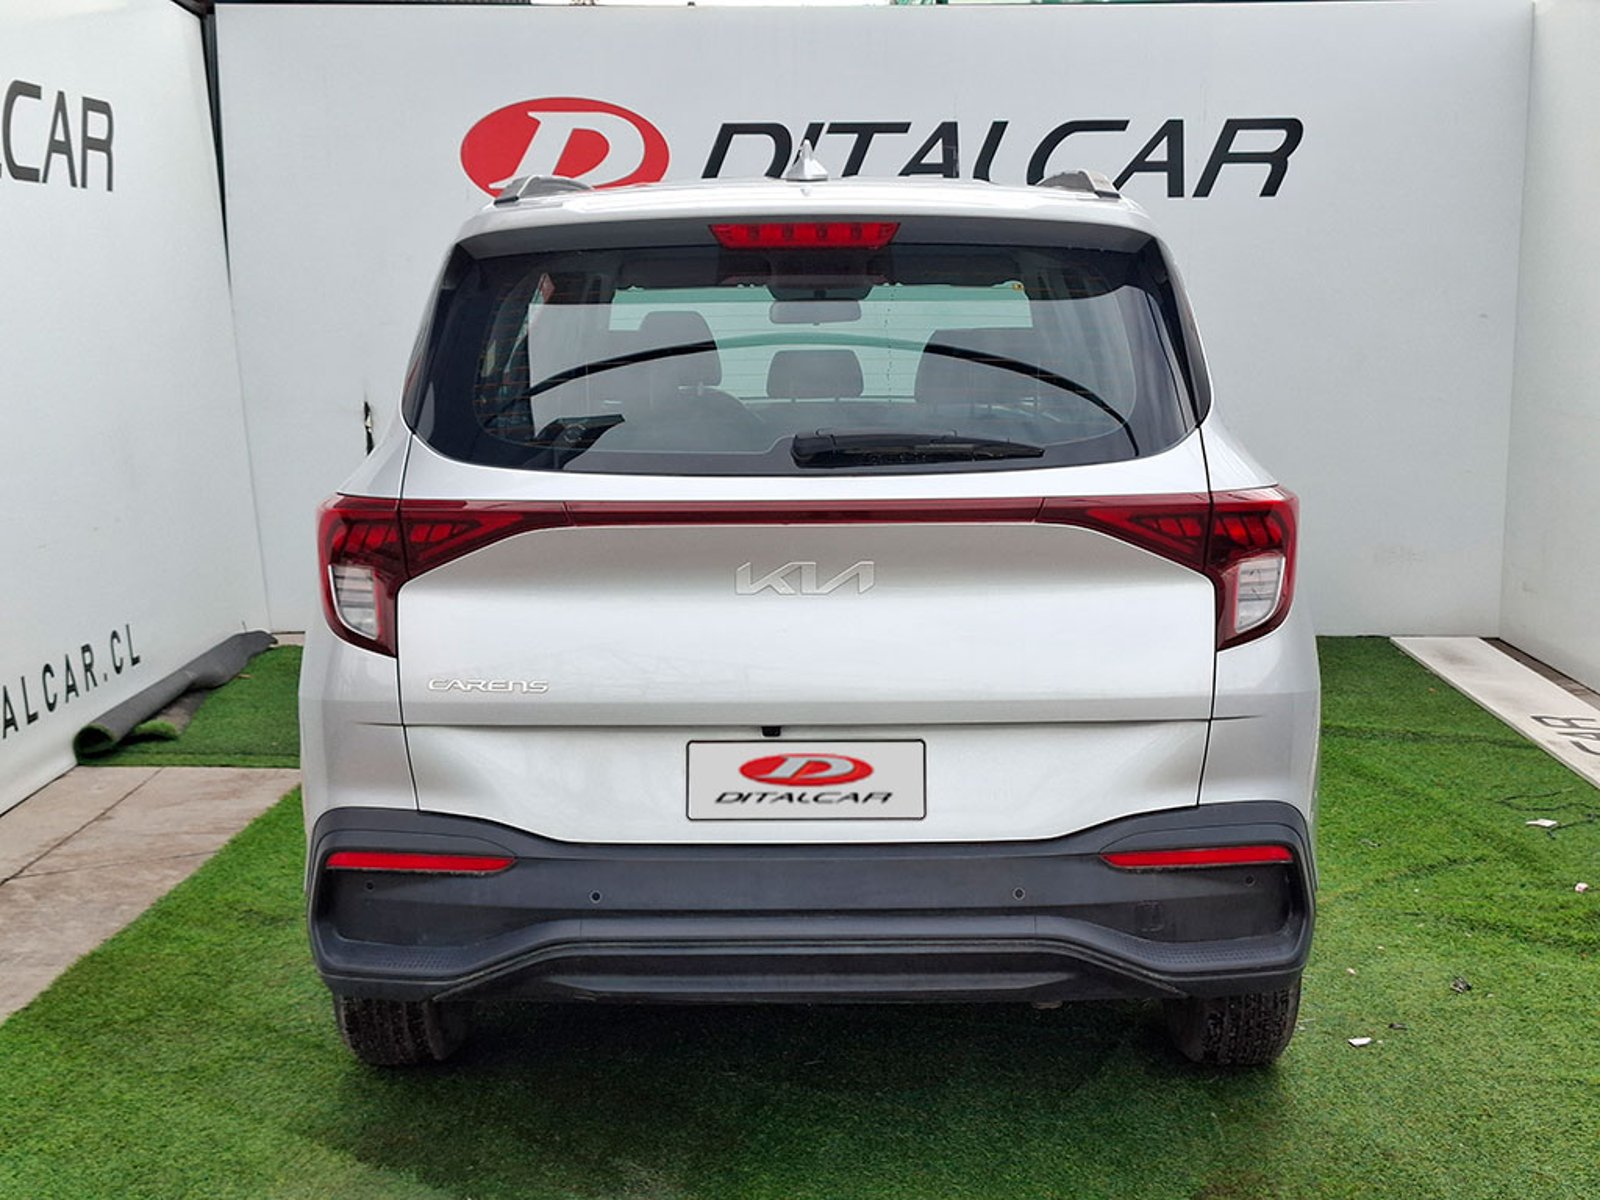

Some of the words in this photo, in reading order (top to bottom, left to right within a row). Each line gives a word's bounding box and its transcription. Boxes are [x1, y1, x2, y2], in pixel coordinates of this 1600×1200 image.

[736, 561, 875, 595] KIA
[3, 624, 141, 739] ALCAR.CL
[428, 678, 549, 694] CARENS
[715, 791, 893, 804] DITALCAR
